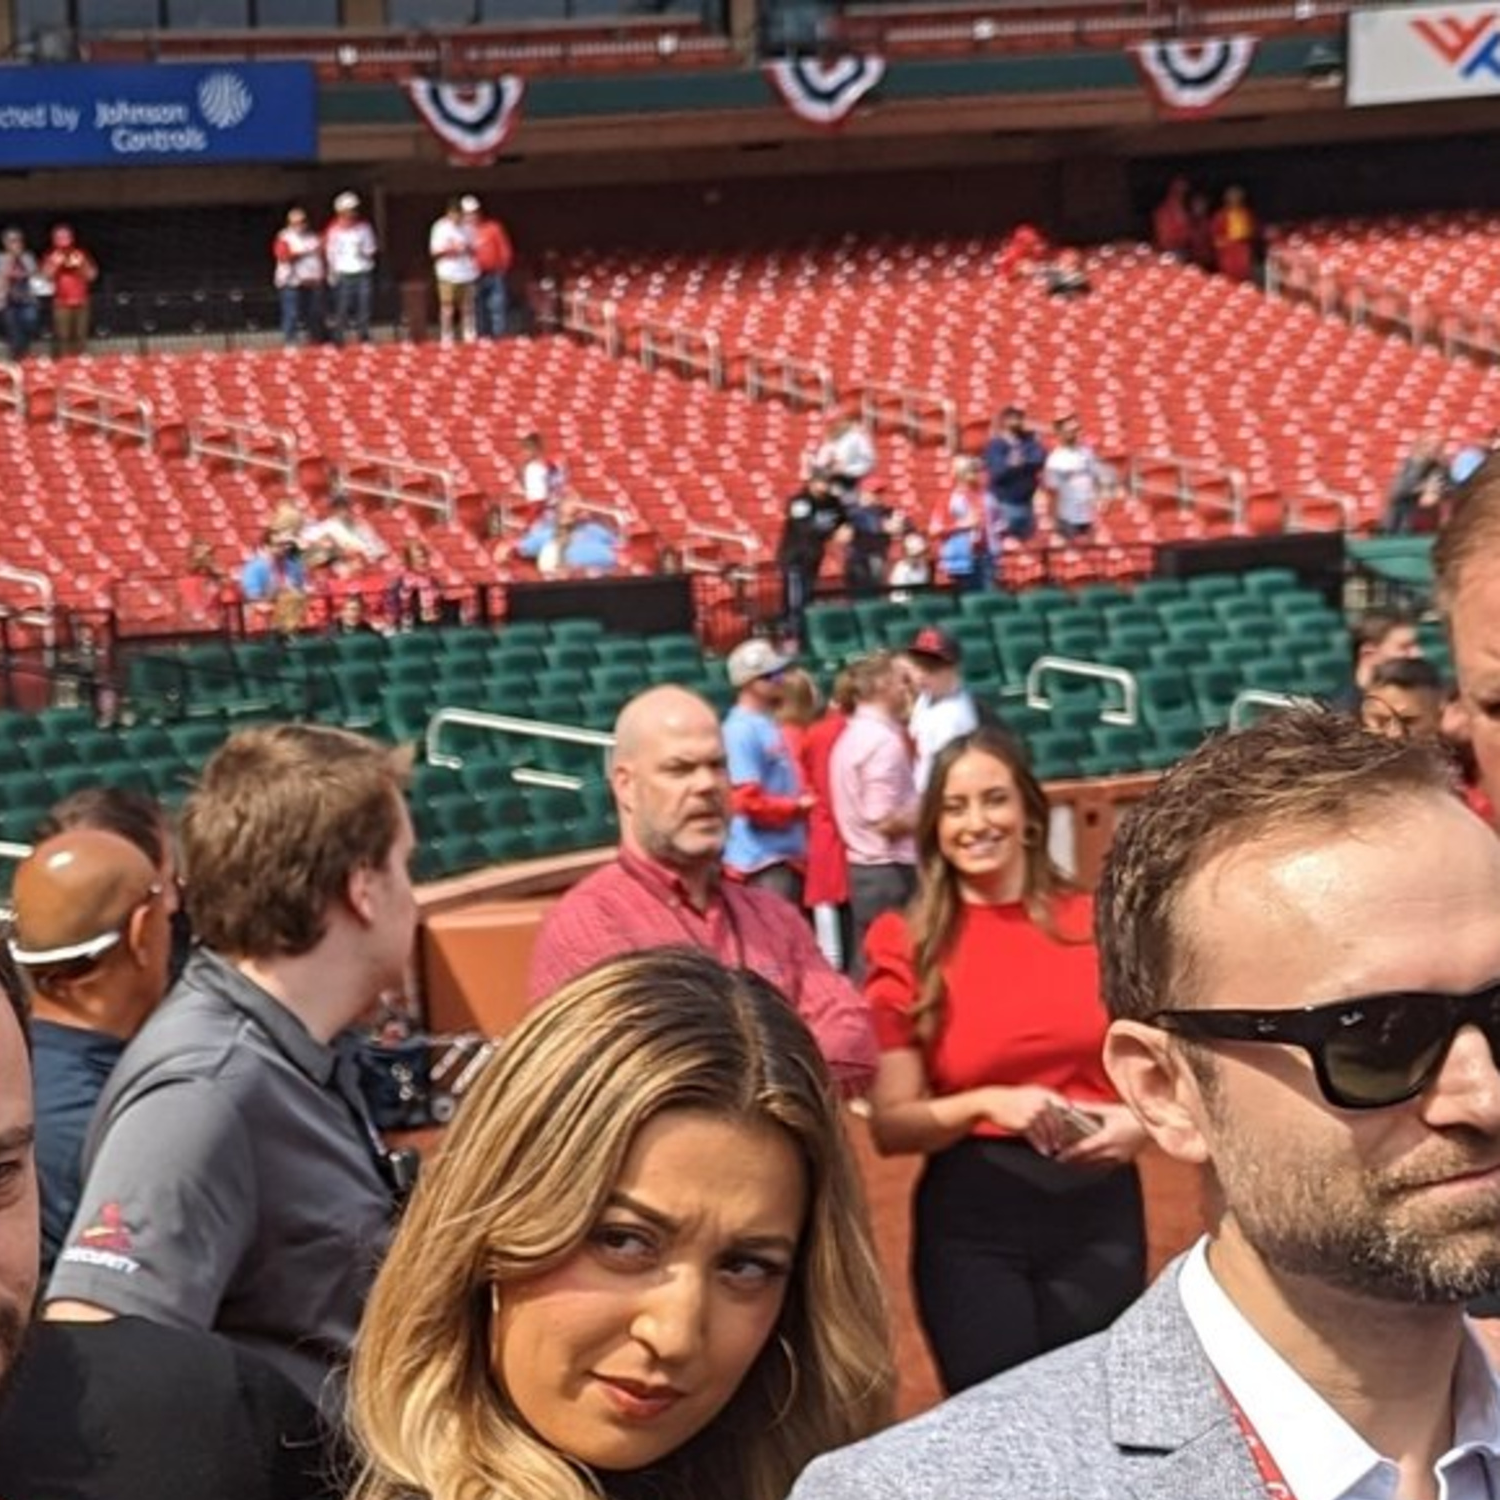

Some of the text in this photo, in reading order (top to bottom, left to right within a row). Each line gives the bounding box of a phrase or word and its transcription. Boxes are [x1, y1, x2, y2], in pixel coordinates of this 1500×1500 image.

[50, 102, 81, 133] by
[95, 99, 190, 129] Johnson
[111, 126, 208, 152] Controls
